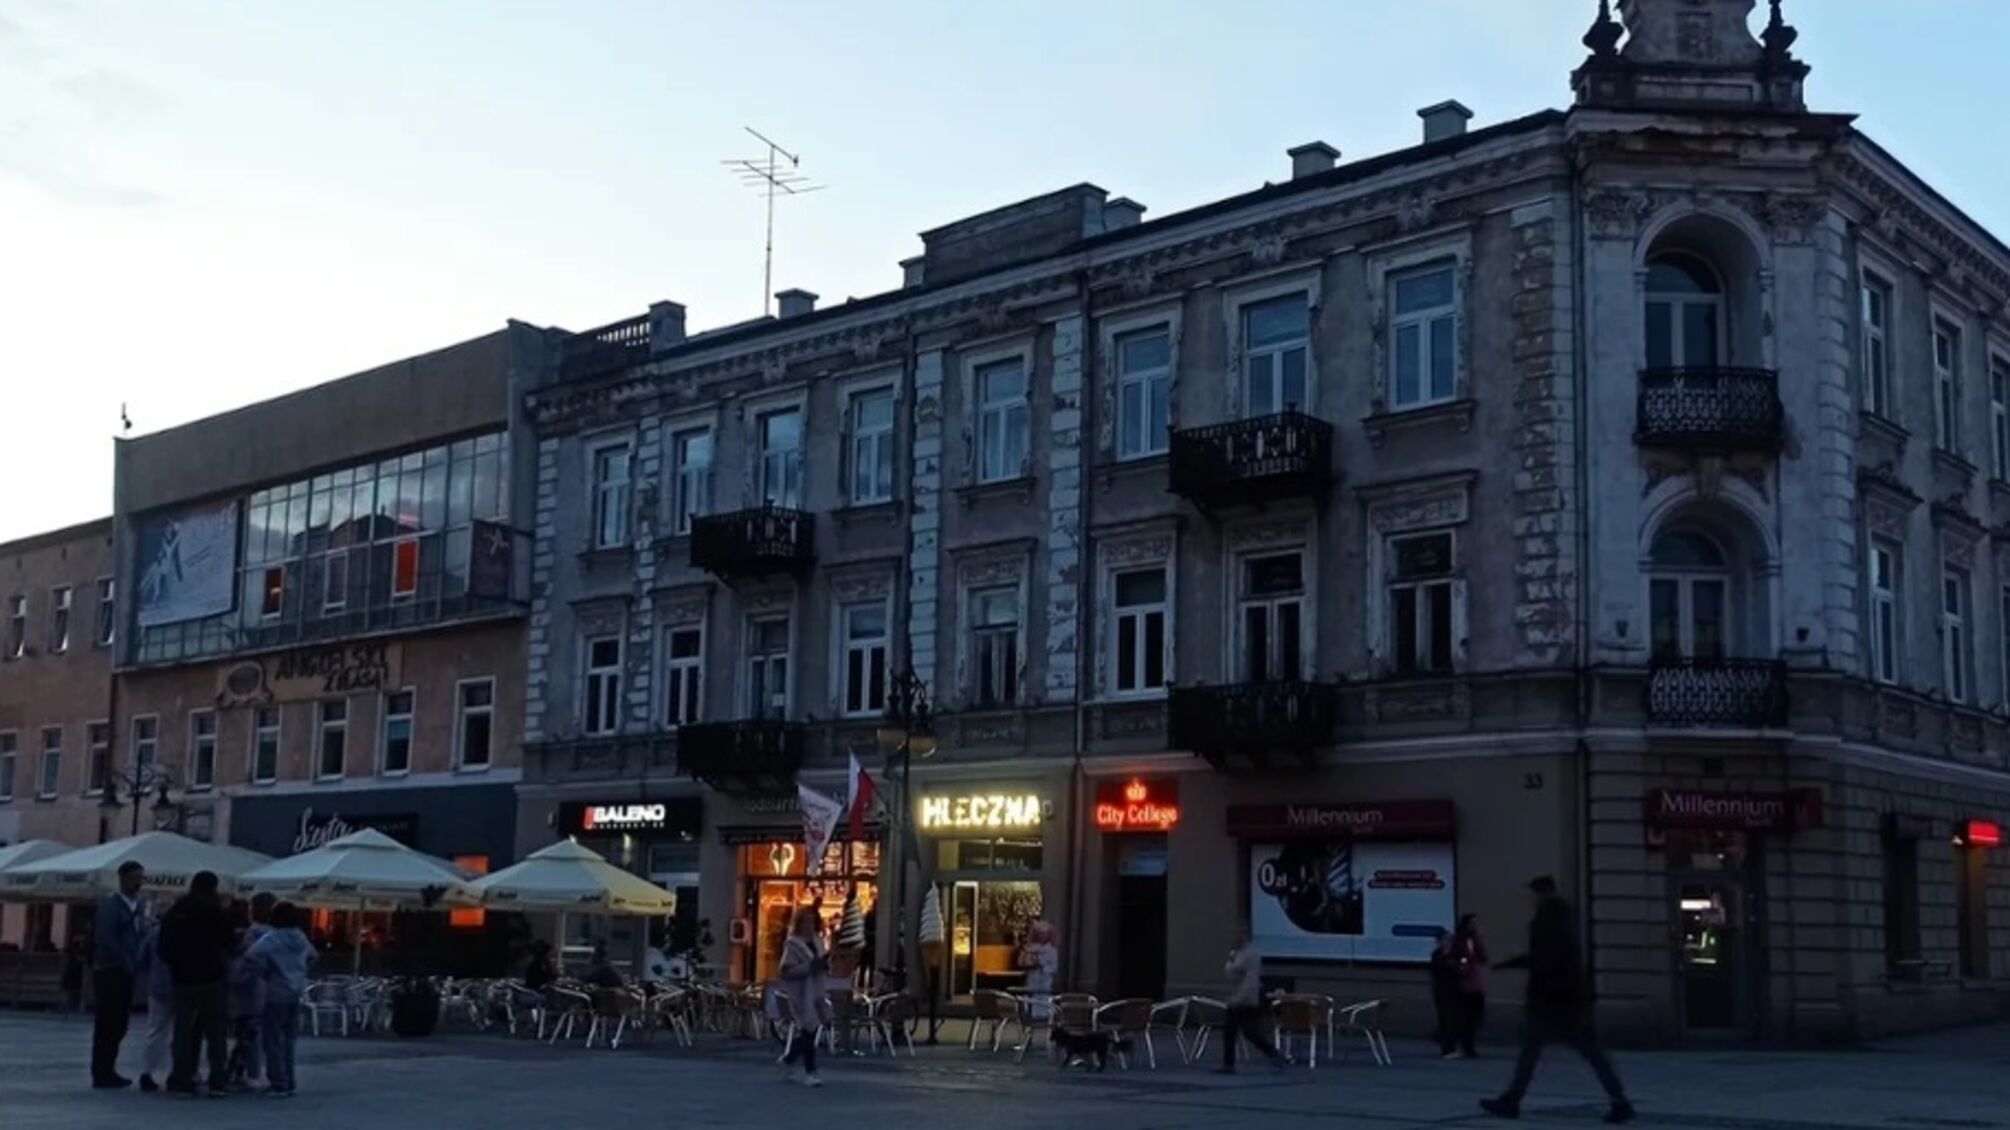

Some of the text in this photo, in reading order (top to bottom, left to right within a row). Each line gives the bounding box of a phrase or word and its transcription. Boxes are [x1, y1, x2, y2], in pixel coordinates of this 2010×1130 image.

[593, 804, 665, 824] BALENO
[1286, 804, 1383, 826] Millennium
[1661, 790, 1785, 816] Millennium
[1097, 804, 1178, 830] City College
